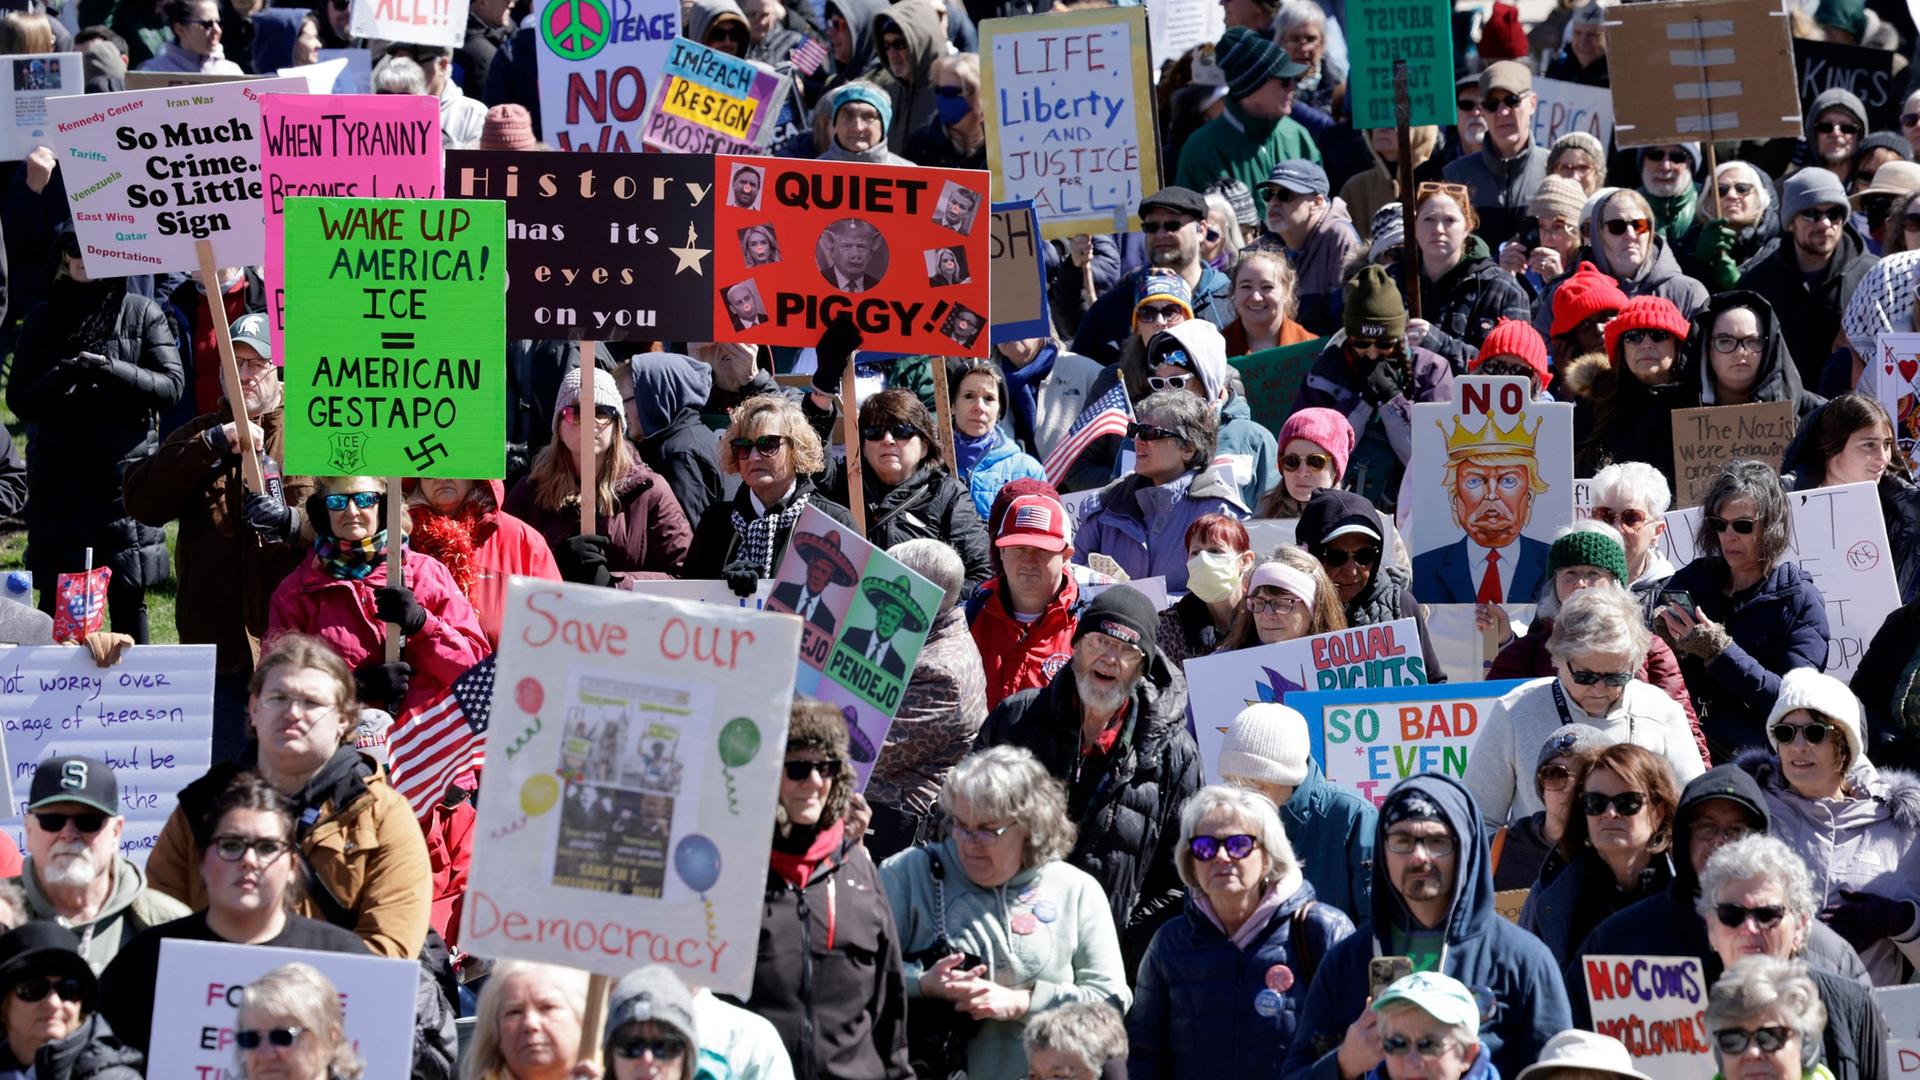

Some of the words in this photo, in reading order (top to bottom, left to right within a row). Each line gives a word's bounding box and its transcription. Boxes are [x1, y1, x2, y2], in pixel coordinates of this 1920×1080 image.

[610, 0, 677, 44] PEACE
[672, 45, 752, 92] IMPEACH
[1014, 34, 1105, 75] LIFE
[566, 66, 647, 125] NO
[1801, 57, 1889, 108] KINGS
[57, 112, 105, 133] Kennedy
[107, 100, 145, 118] Center
[167, 98, 190, 108] Iran
[192, 95, 216, 106] War
[672, 80, 754, 131] RESIGN
[1001, 86, 1124, 129] Liberty
[115, 126, 158, 150] So
[160, 117, 254, 148] Much
[263, 115, 322, 157] WHEN
[321, 114, 432, 157] TYRANNY
[1042, 127, 1092, 145] AND
[70, 148, 108, 162] Tariffs
[1008, 146, 1138, 181] JUSTICE
[70, 170, 123, 202] Venezuela
[126, 184, 168, 208] So
[171, 177, 263, 206] Little
[460, 165, 712, 207] History
[775, 171, 928, 215] QUIET
[1059, 177, 1082, 187] FOR
[77, 212, 102, 222] East
[105, 212, 135, 224] Wing
[156, 210, 231, 239] Sign
[318, 207, 405, 241] WAKE
[420, 208, 471, 241] UP
[507, 219, 565, 241] has
[610, 222, 659, 245] its
[115, 232, 148, 242] Qatar
[87, 245, 162, 265] Deportations
[328, 245, 490, 281] AMERICA!
[534, 265, 634, 286] eyes
[362, 288, 427, 320] ICE
[534, 306, 577, 325] on
[592, 310, 657, 329] you
[311, 357, 481, 391] AMERICAN
[308, 396, 456, 429] GESTAPO
[1462, 383, 1524, 415] NO
[337, 436, 360, 448] ICE
[1688, 414, 1732, 440] The
[1738, 416, 1794, 440] Nazis
[1679, 443, 1727, 462] were
[522, 590, 629, 656] Save
[1311, 626, 1406, 670] EQUAL
[830, 650, 901, 709] PENDEJO
[62, 705, 83, 730] of
[1326, 709, 1381, 744] SO
[1399, 703, 1478, 741] BAD
[150, 748, 176, 769] be
[122, 785, 158, 810] the
